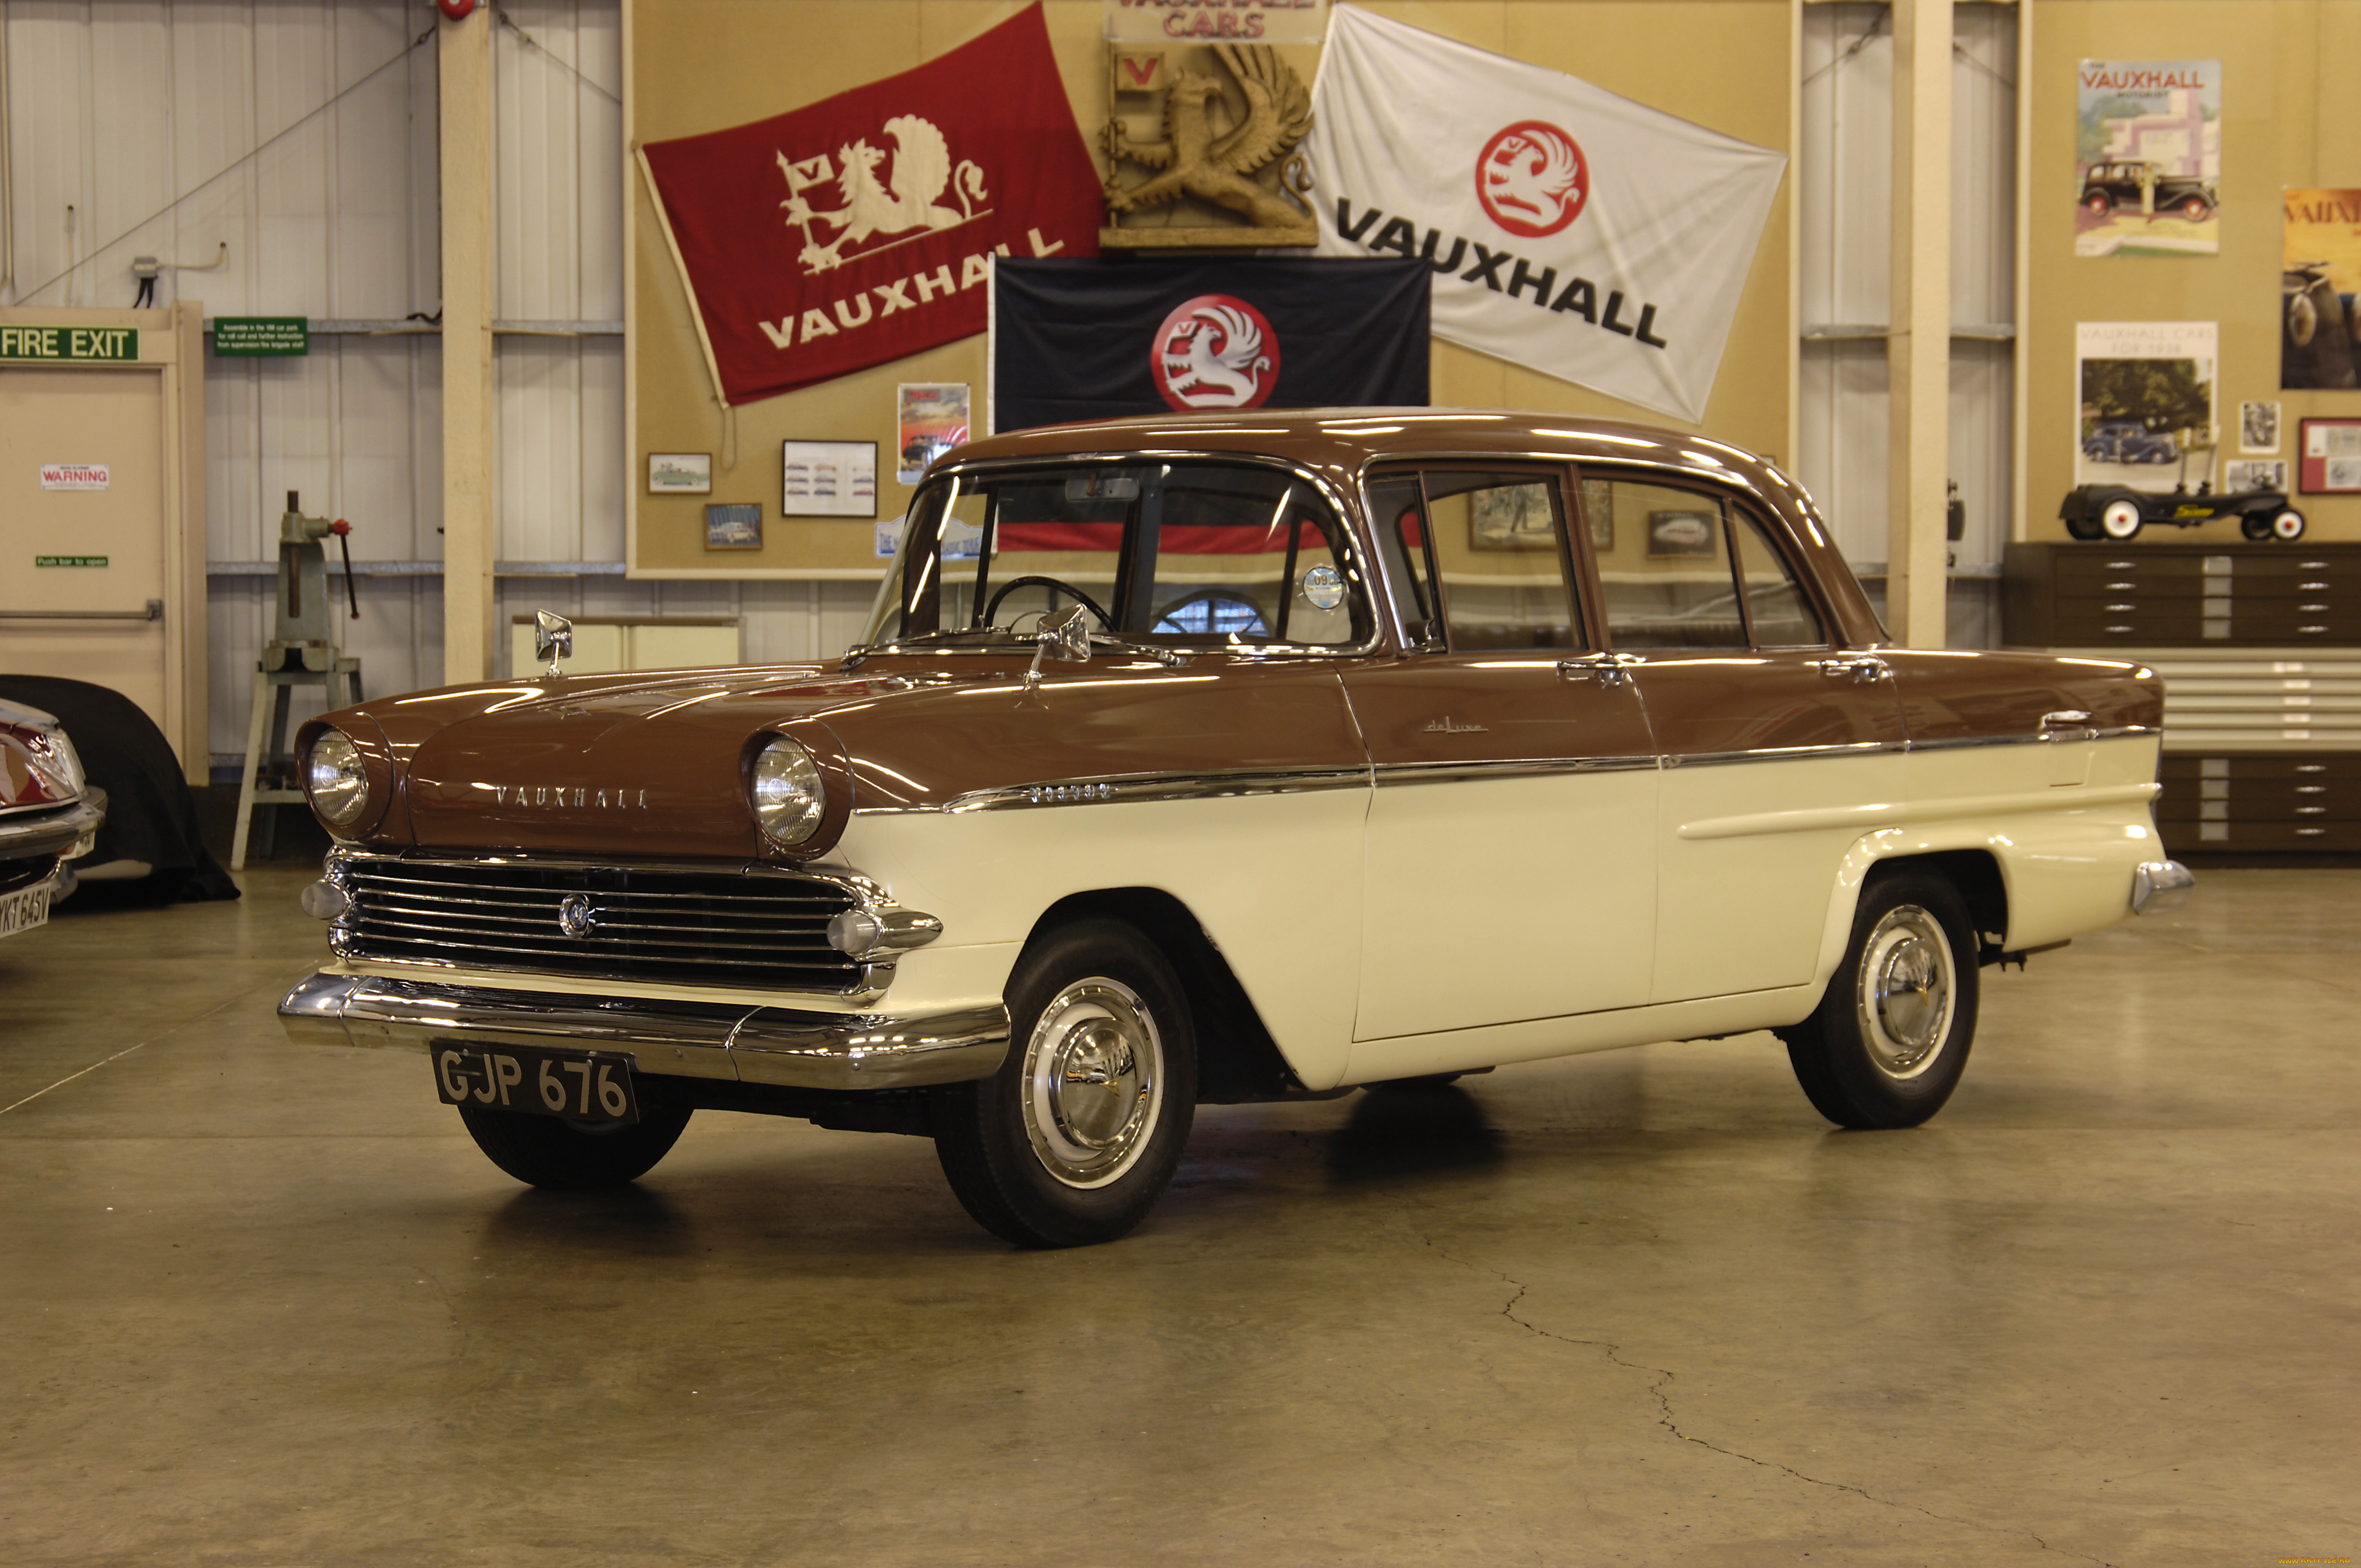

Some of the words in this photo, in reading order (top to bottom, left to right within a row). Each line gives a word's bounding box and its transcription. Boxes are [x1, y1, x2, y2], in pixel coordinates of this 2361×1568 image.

[1163, 10, 1265, 37] CARS
[1124, 58, 1157, 85] V
[2080, 70, 2205, 89] VAUXHALL
[1336, 197, 1667, 349] VAUXHALL
[2, 329, 59, 357] FIRE
[71, 329, 129, 357] EXIT
[2081, 328, 2167, 340] VAUXHALL
[2112, 342, 2141, 354] FOR
[43, 471, 107, 482] WARNING
[37, 557, 56, 565] Push
[87, 558, 106, 567] open
[1314, 575, 1328, 586] 09
[496, 787, 646, 809] VAUXHALL
[20, 887, 50, 926] 645V
[440, 1050, 522, 1106] GJP
[539, 1059, 627, 1117] 676
